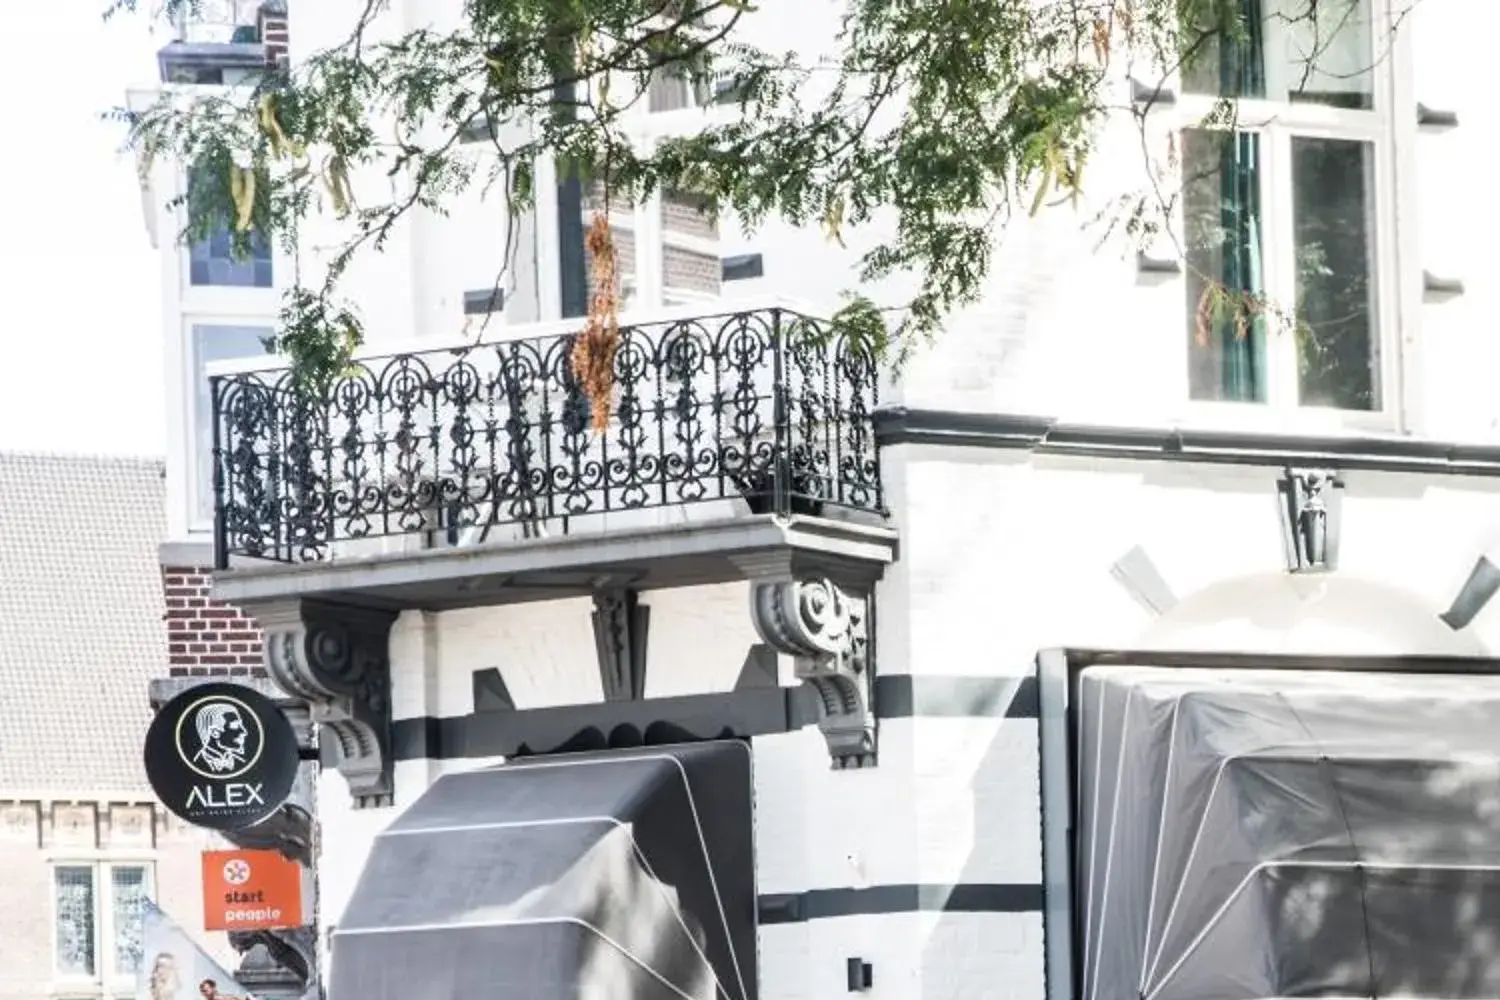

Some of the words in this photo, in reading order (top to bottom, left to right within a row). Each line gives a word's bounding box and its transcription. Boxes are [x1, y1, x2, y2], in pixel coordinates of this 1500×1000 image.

[185, 782, 265, 809] ALEX
[224, 890, 264, 903] start
[224, 906, 282, 922] people
